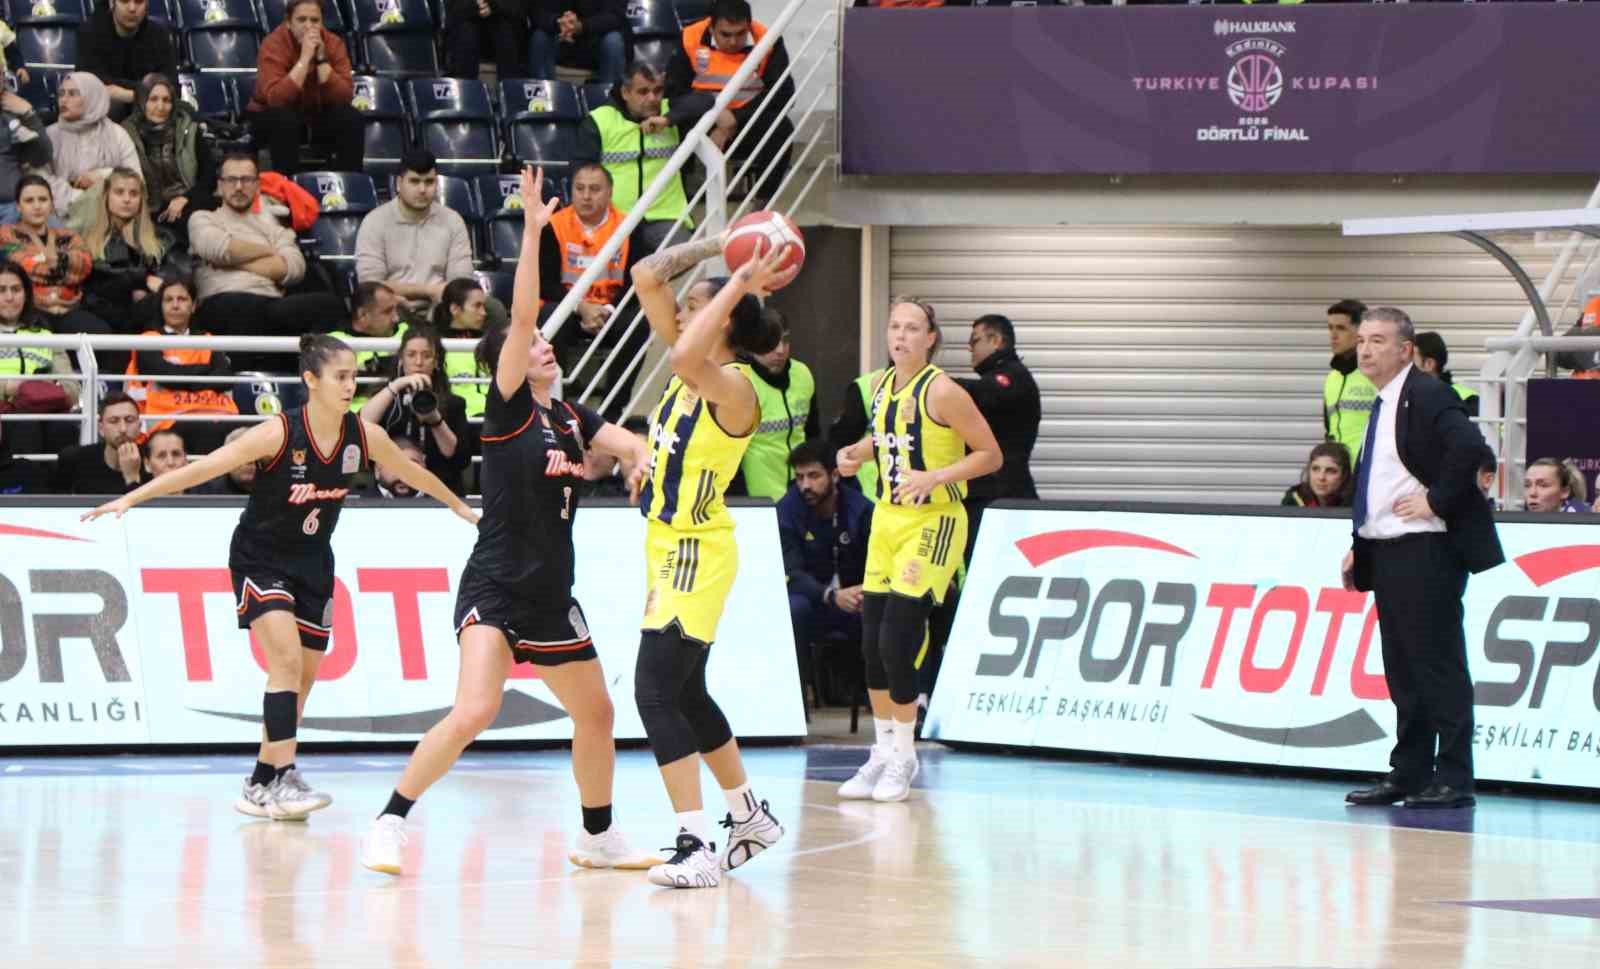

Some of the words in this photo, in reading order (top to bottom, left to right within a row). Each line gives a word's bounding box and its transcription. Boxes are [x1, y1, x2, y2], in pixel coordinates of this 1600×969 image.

[1230, 21, 1296, 33] HALKBANK
[1292, 76, 1378, 90] KUPASI
[1197, 126, 1259, 141] DÖRTLÜ
[1263, 126, 1309, 141] FİNAL
[302, 508, 321, 536] 6
[1472, 594, 1600, 709] SP
[967, 692, 1048, 716] TEŞKİLAT
[1056, 698, 1168, 722] BAŞKANLIĞI
[1472, 723, 1558, 749] EŞKİLAT
